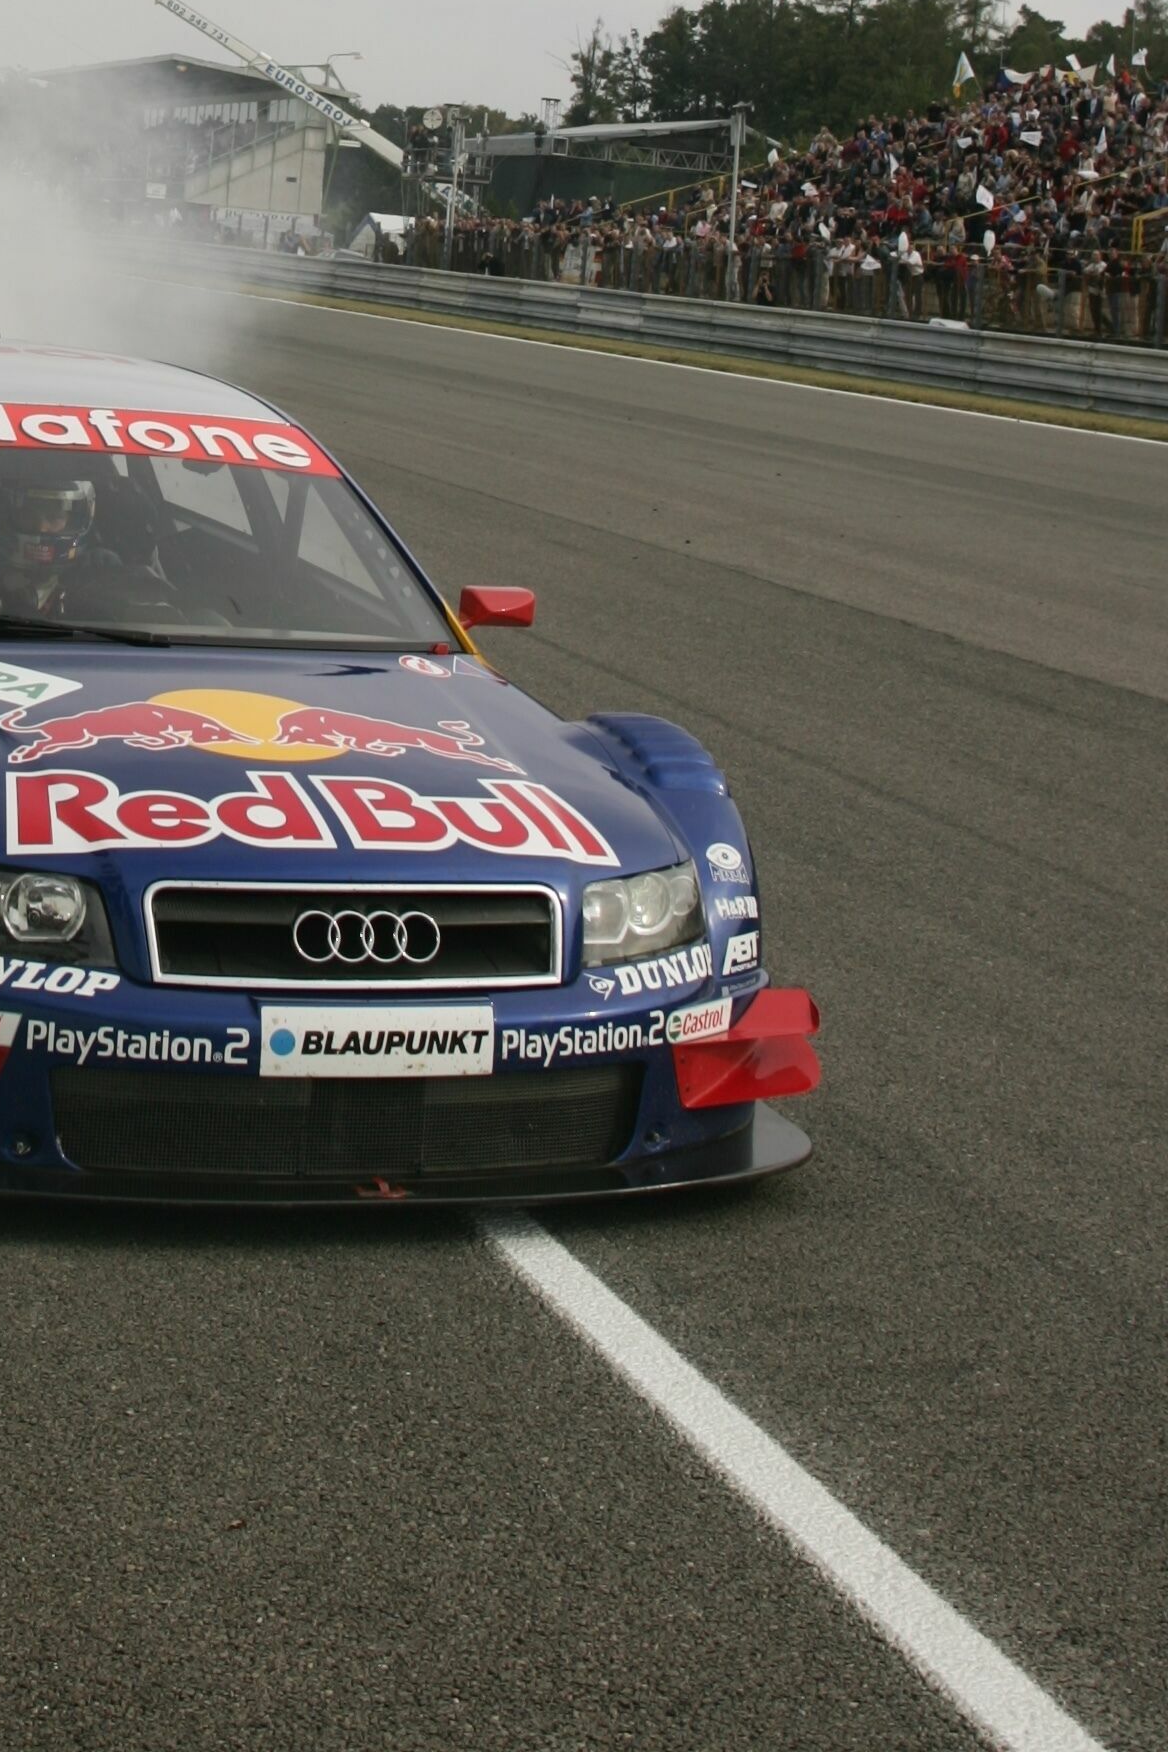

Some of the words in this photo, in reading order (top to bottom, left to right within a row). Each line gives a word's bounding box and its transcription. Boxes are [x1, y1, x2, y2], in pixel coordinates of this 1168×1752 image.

[6, 772, 337, 856] Red
[309, 774, 621, 866] Bull
[682, 1006, 723, 1034] Castrol
[301, 1031, 488, 1055] BLAUPUNKT
